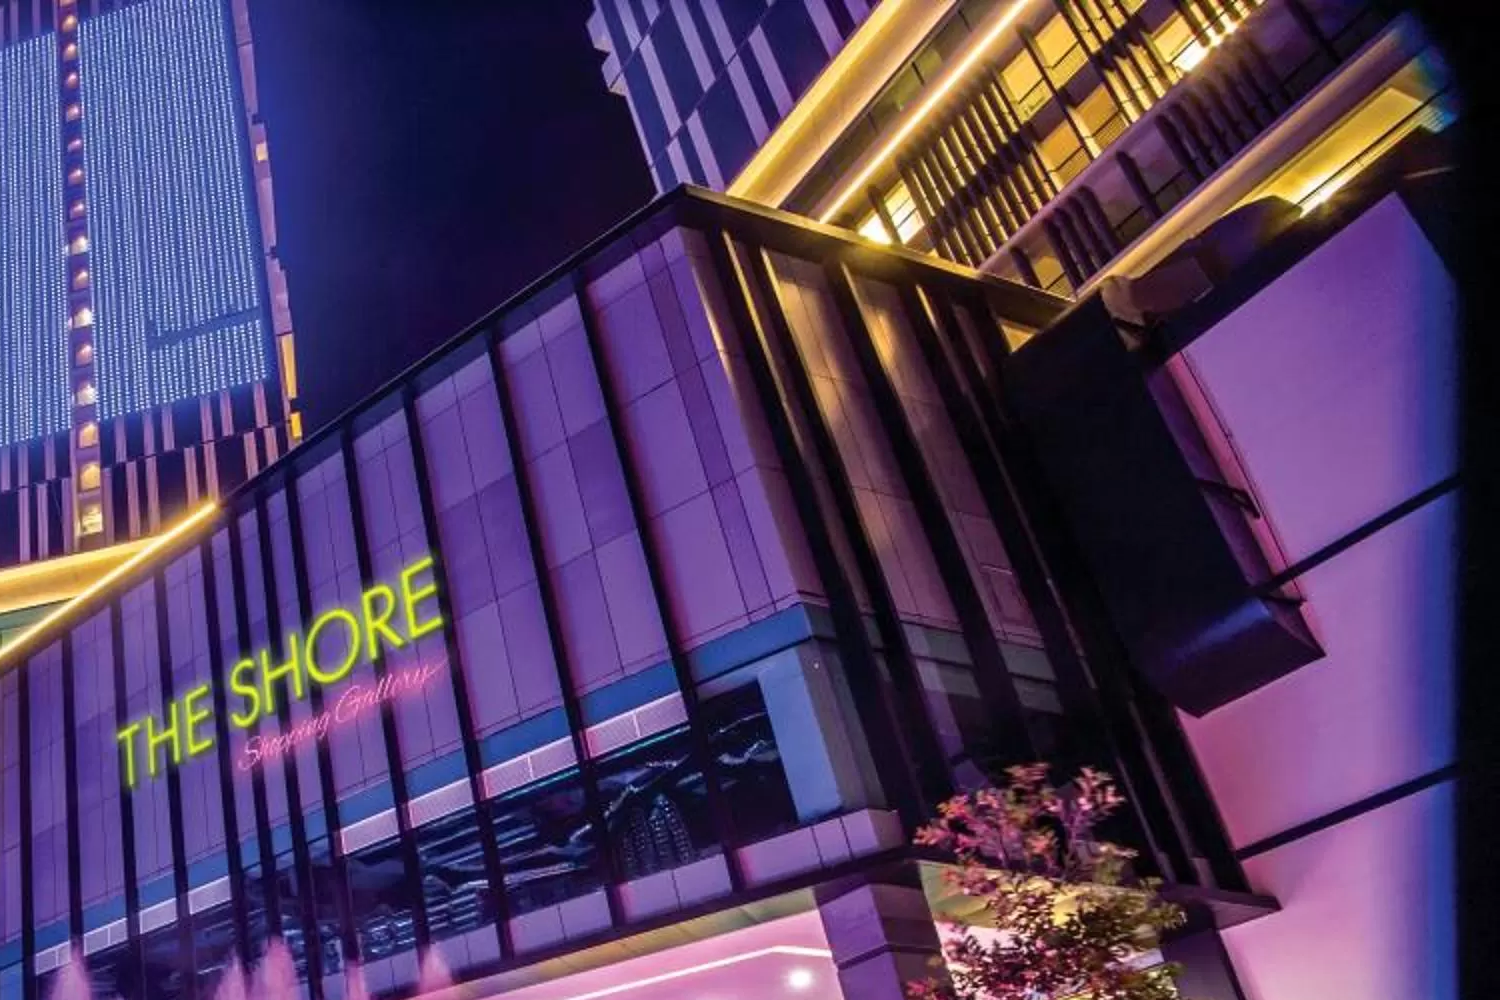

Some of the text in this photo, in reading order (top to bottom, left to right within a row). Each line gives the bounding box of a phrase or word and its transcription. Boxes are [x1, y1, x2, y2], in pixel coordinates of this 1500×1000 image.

[116, 556, 445, 787] THE SHORE
[335, 657, 449, 724] Gallery
